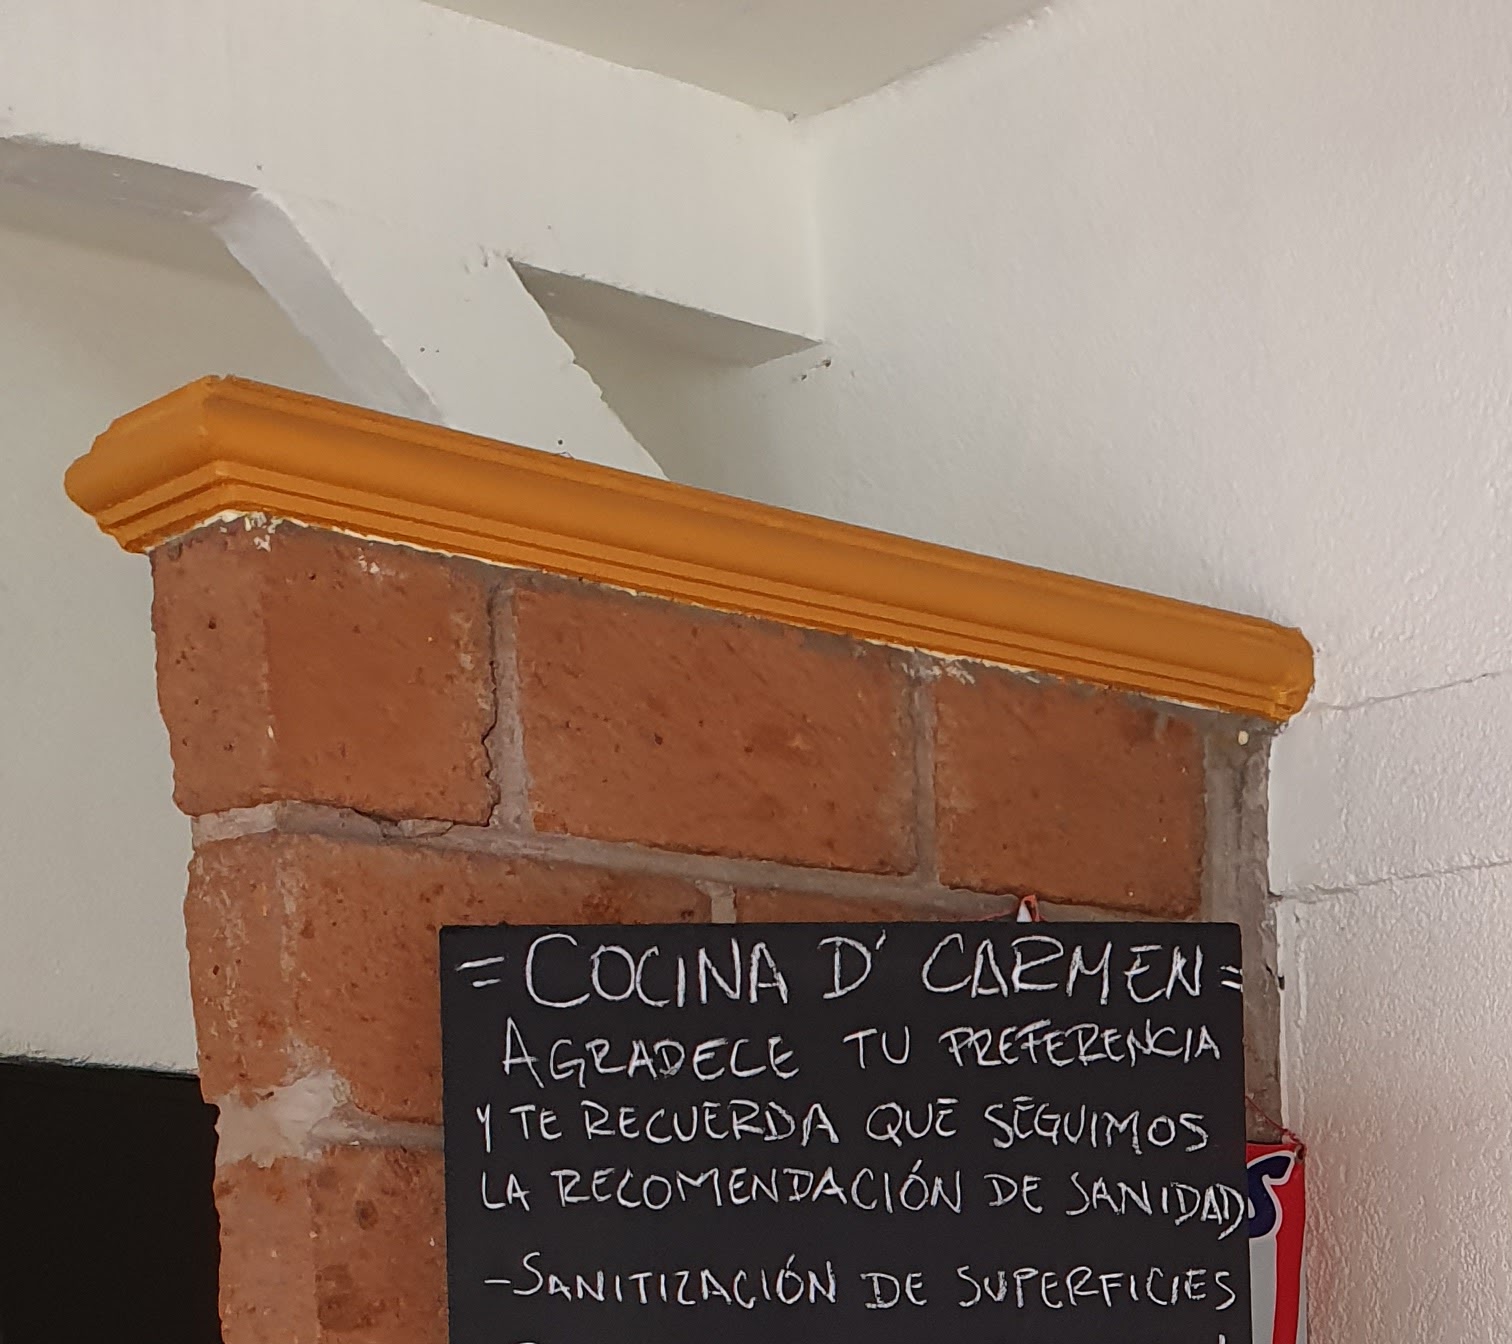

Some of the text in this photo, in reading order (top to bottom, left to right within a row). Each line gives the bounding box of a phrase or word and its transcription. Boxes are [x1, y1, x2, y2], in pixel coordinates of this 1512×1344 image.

[502, 1016, 1222, 1090] AGRADECE TU PREFERENCIA
[475, 1102, 492, 1154] Y
[508, 1103, 563, 1141] TE
[580, 1098, 841, 1148] RECUERDA
[480, 1170, 531, 1213] LA
[549, 1158, 962, 1215] RECOMENDACIÓN
[982, 1172, 1044, 1215] DE
[1064, 1170, 1246, 1242] SANIDAD
[859, 1271, 928, 1310] DE
[955, 1265, 1238, 1312] SUPERFICIES
